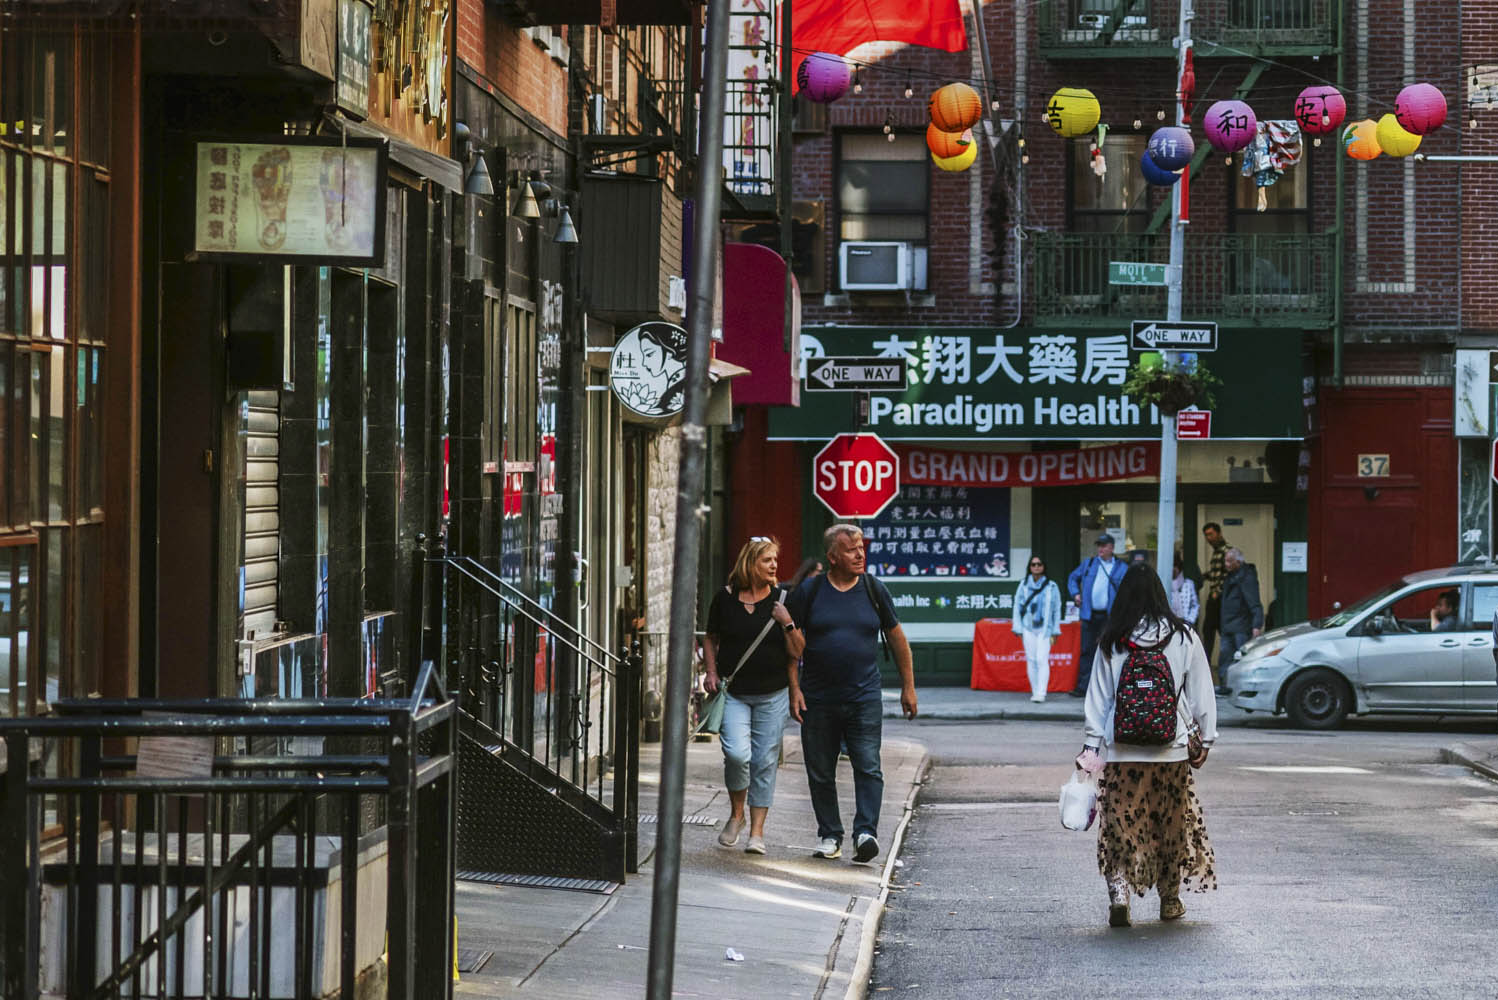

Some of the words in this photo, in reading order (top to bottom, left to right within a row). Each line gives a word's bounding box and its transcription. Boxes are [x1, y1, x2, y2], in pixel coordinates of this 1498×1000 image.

[1215, 109, 1248, 137] 和
[1296, 97, 1319, 128] 安
[1145, 330, 1169, 342] ONE
[1180, 331, 1206, 343] WAY
[616, 351, 637, 369] 杜
[821, 367, 850, 380] ONE
[863, 367, 894, 381] WAY
[869, 395, 1025, 433] Paradigm
[1034, 395, 1140, 426] Health
[819, 459, 894, 492] STOP
[908, 448, 1008, 484] GRAND
[1019, 446, 1147, 484] OPENING
[1360, 455, 1388, 477] 37
[893, 594, 915, 608] ealth
[916, 595, 931, 608] Inc
[956, 594, 1015, 609] 杰翔大藥
